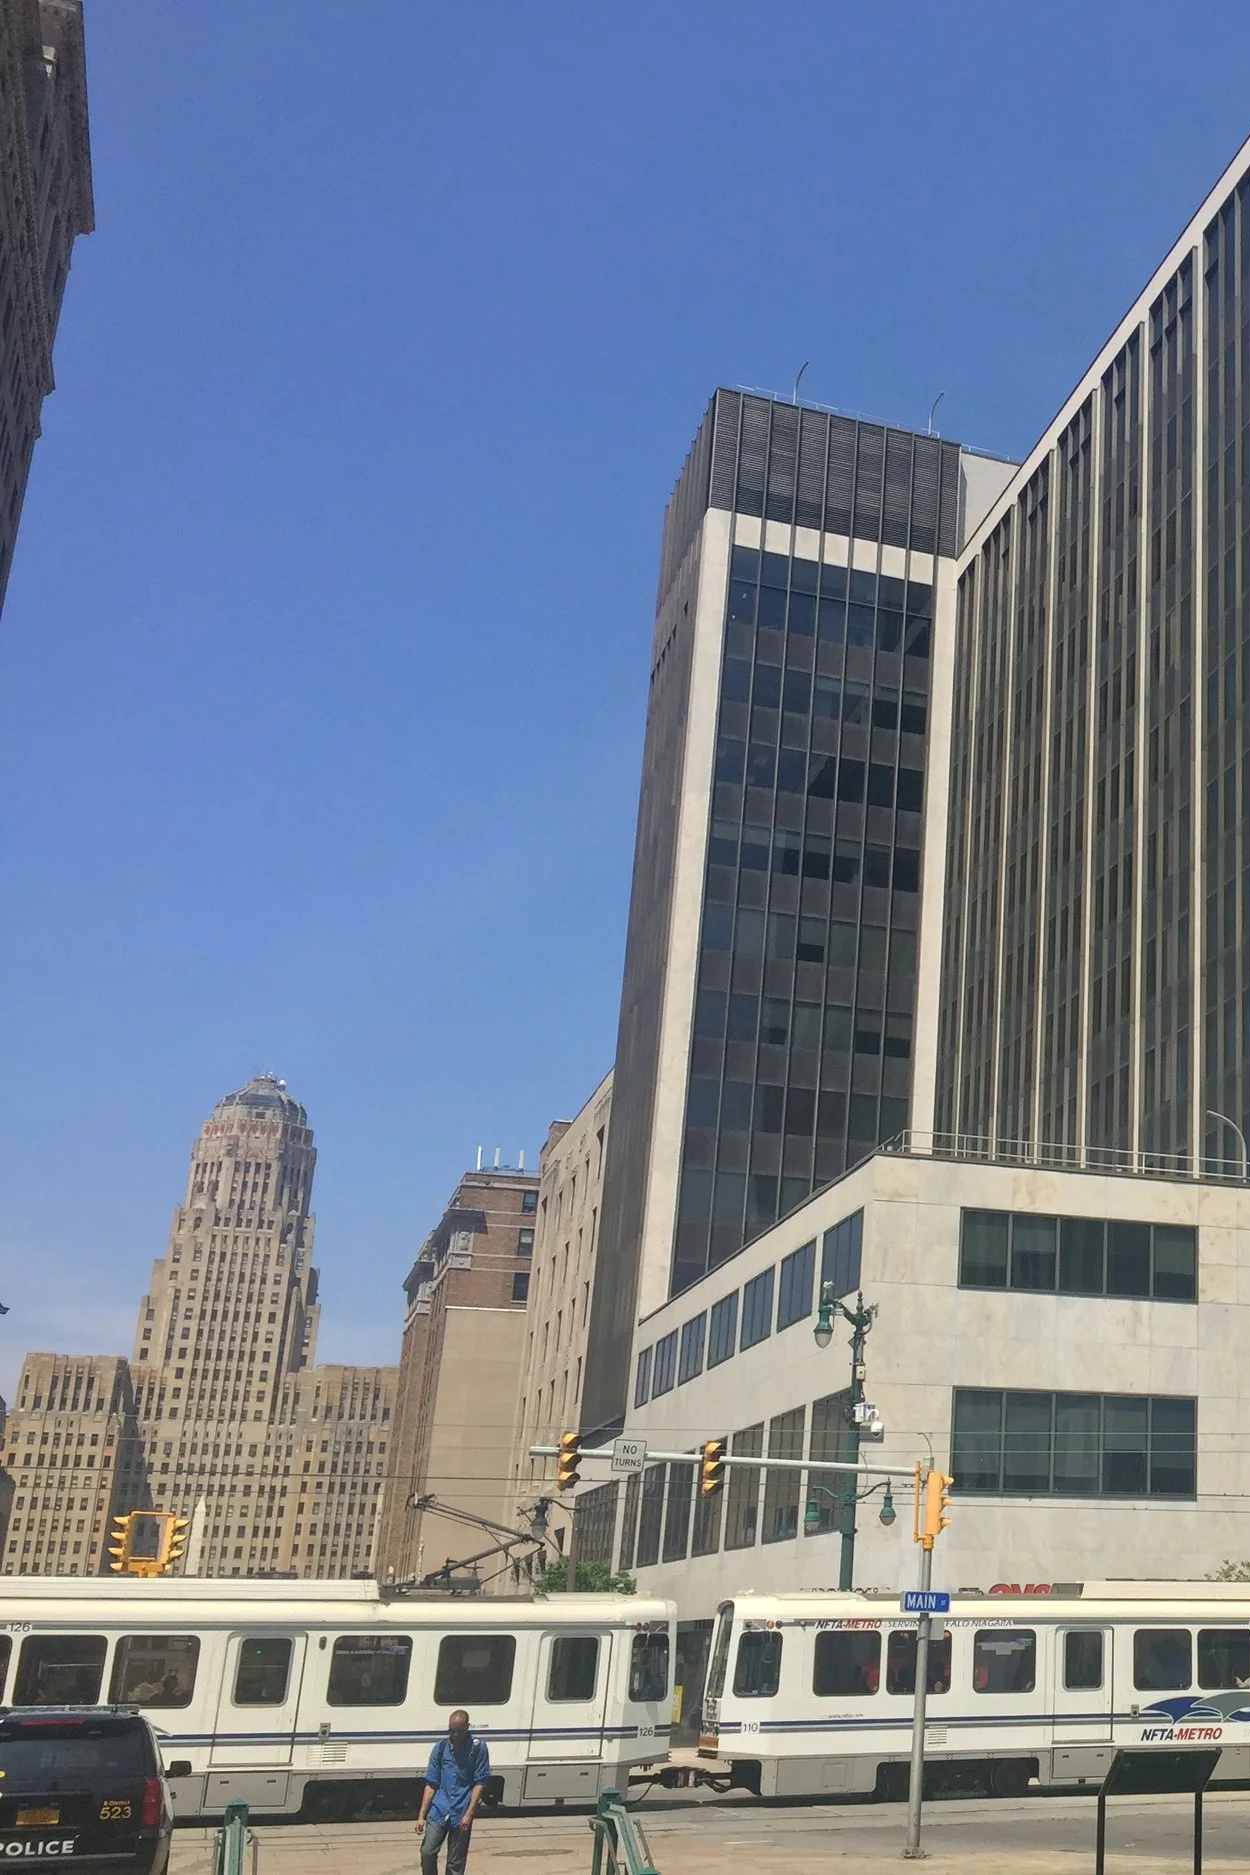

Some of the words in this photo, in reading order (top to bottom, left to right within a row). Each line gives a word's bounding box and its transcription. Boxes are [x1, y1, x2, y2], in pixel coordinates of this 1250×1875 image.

[622, 1445, 637, 1454] NO
[615, 1458, 641, 1467] TURNS
[906, 1593, 936, 1609] MAIN
[10, 1622, 31, 1632] 126
[815, 1619, 882, 1629] NFTA-METRO
[888, 1619, 920, 1628] SERVIN
[971, 1619, 1013, 1627] NIAGARA
[639, 1727, 654, 1737] 126
[743, 1723, 759, 1732] 110
[1141, 1728, 1223, 1741] NFTA-METRO
[99, 1806, 132, 1820] 523
